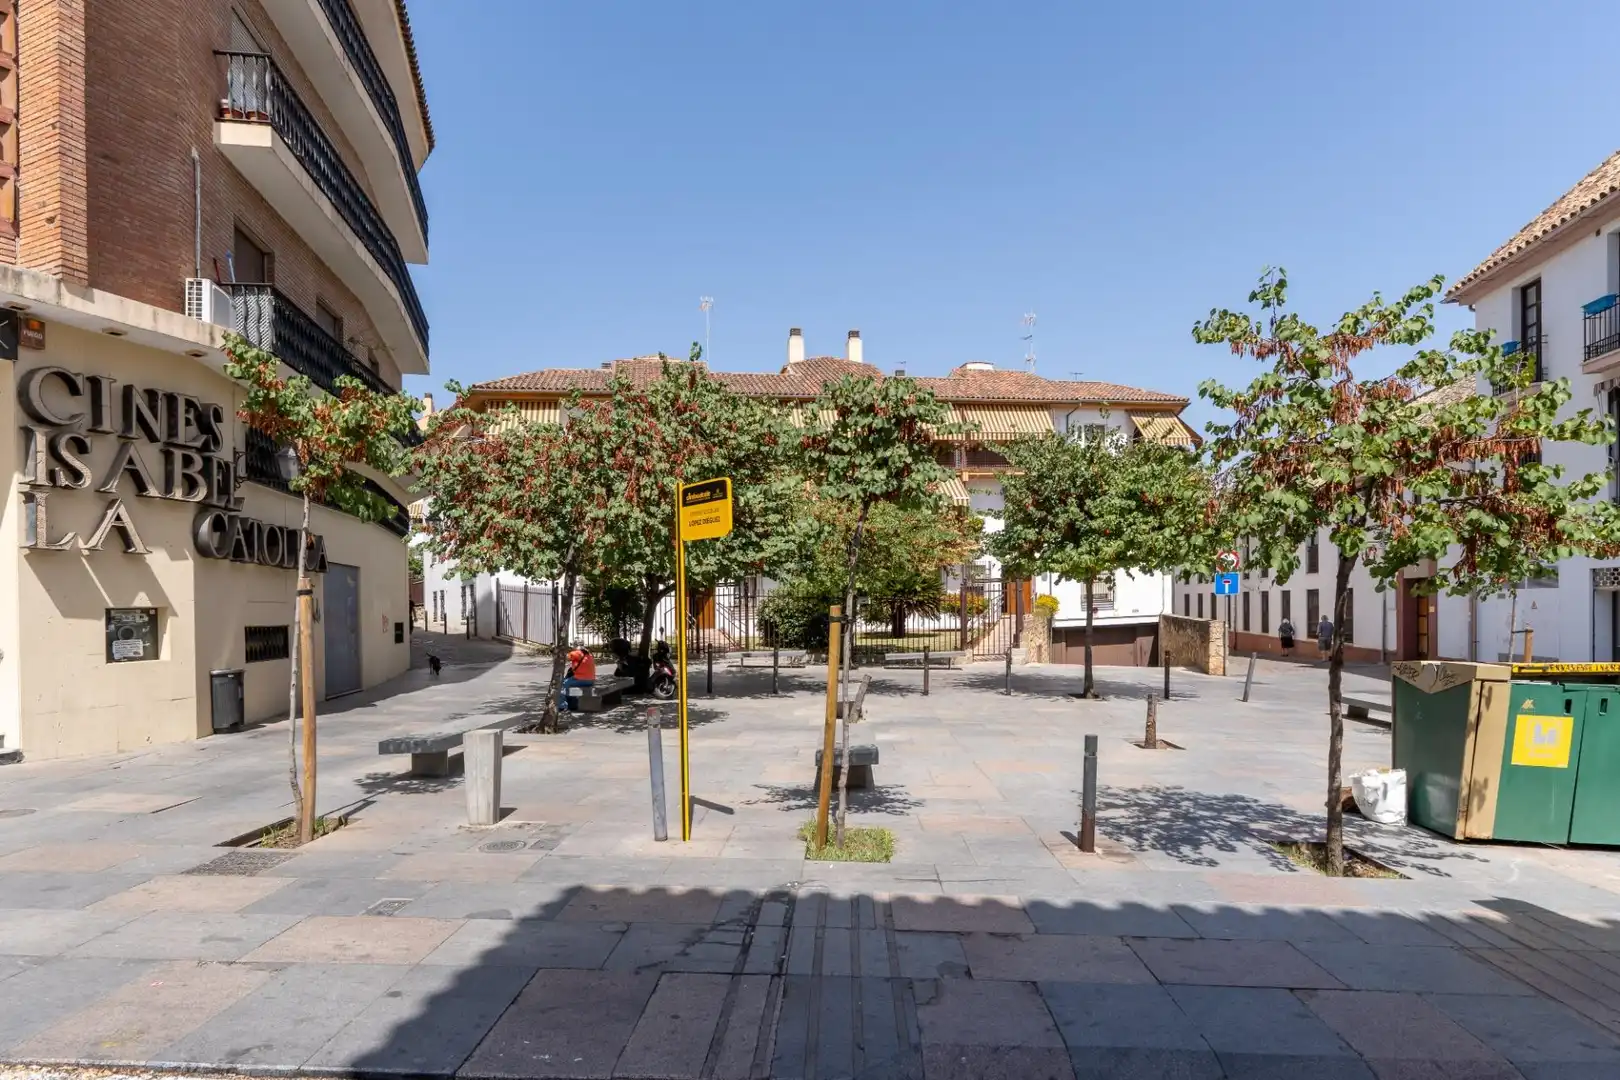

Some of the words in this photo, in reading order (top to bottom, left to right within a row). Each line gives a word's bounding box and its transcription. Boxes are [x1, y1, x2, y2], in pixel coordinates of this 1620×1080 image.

[18, 366, 224, 452] CINES
[19, 423, 245, 512] ISABEL
[19, 490, 152, 554] LA
